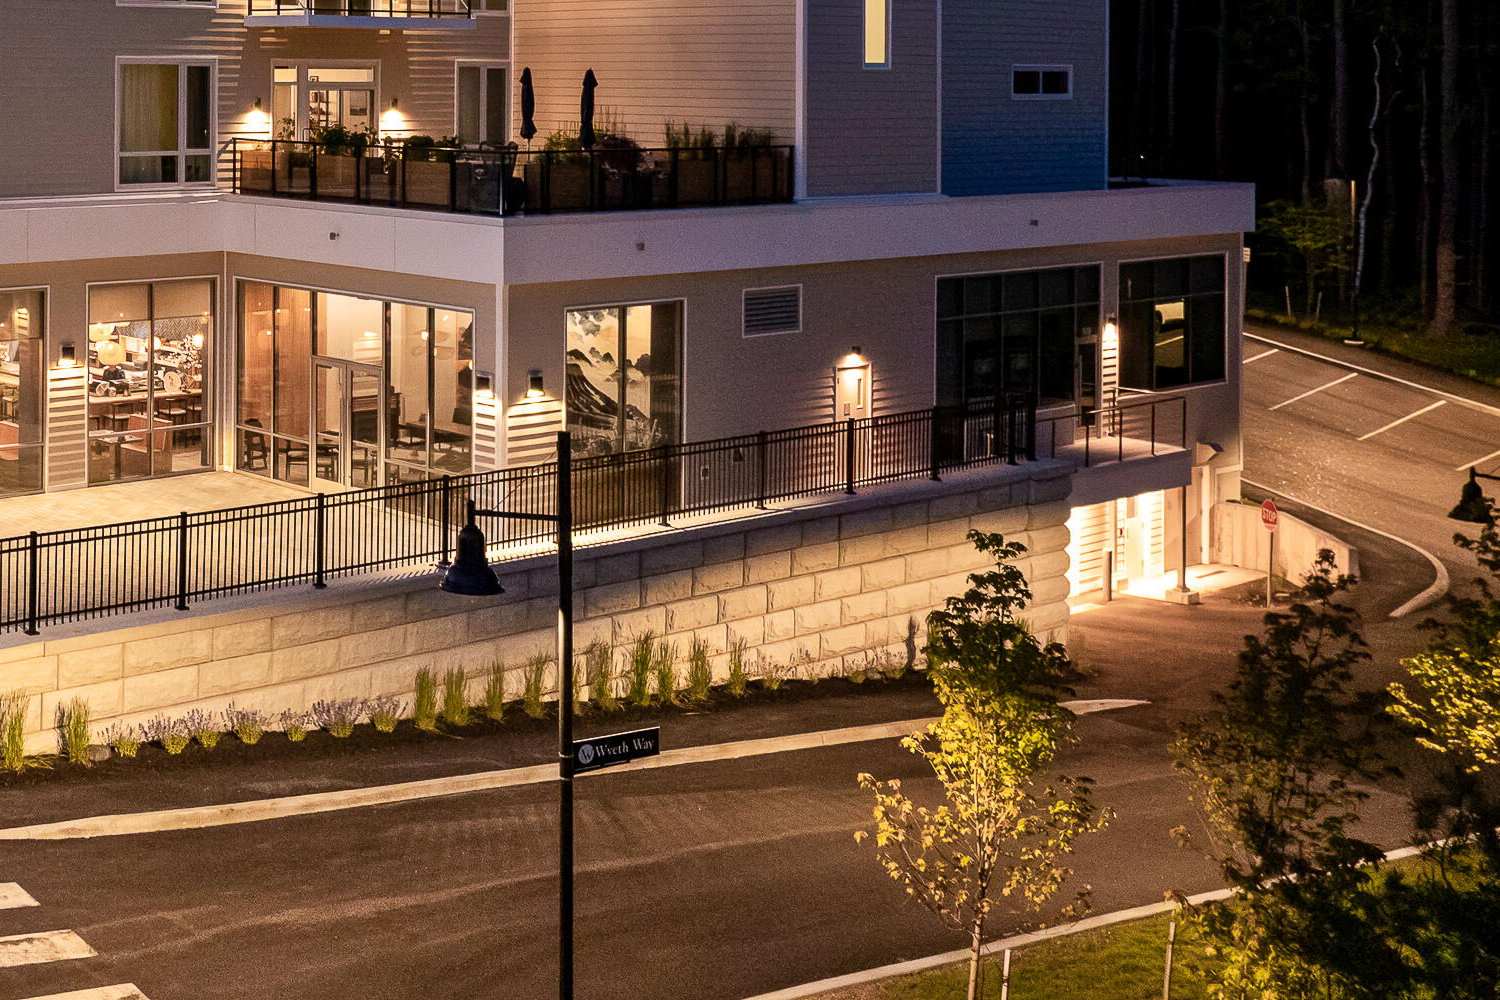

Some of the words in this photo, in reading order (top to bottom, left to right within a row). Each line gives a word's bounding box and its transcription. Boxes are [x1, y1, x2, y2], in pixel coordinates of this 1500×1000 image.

[1262, 507, 1277, 522] STOP
[595, 741, 629, 759] Wyeth
[632, 737, 655, 751] Way
